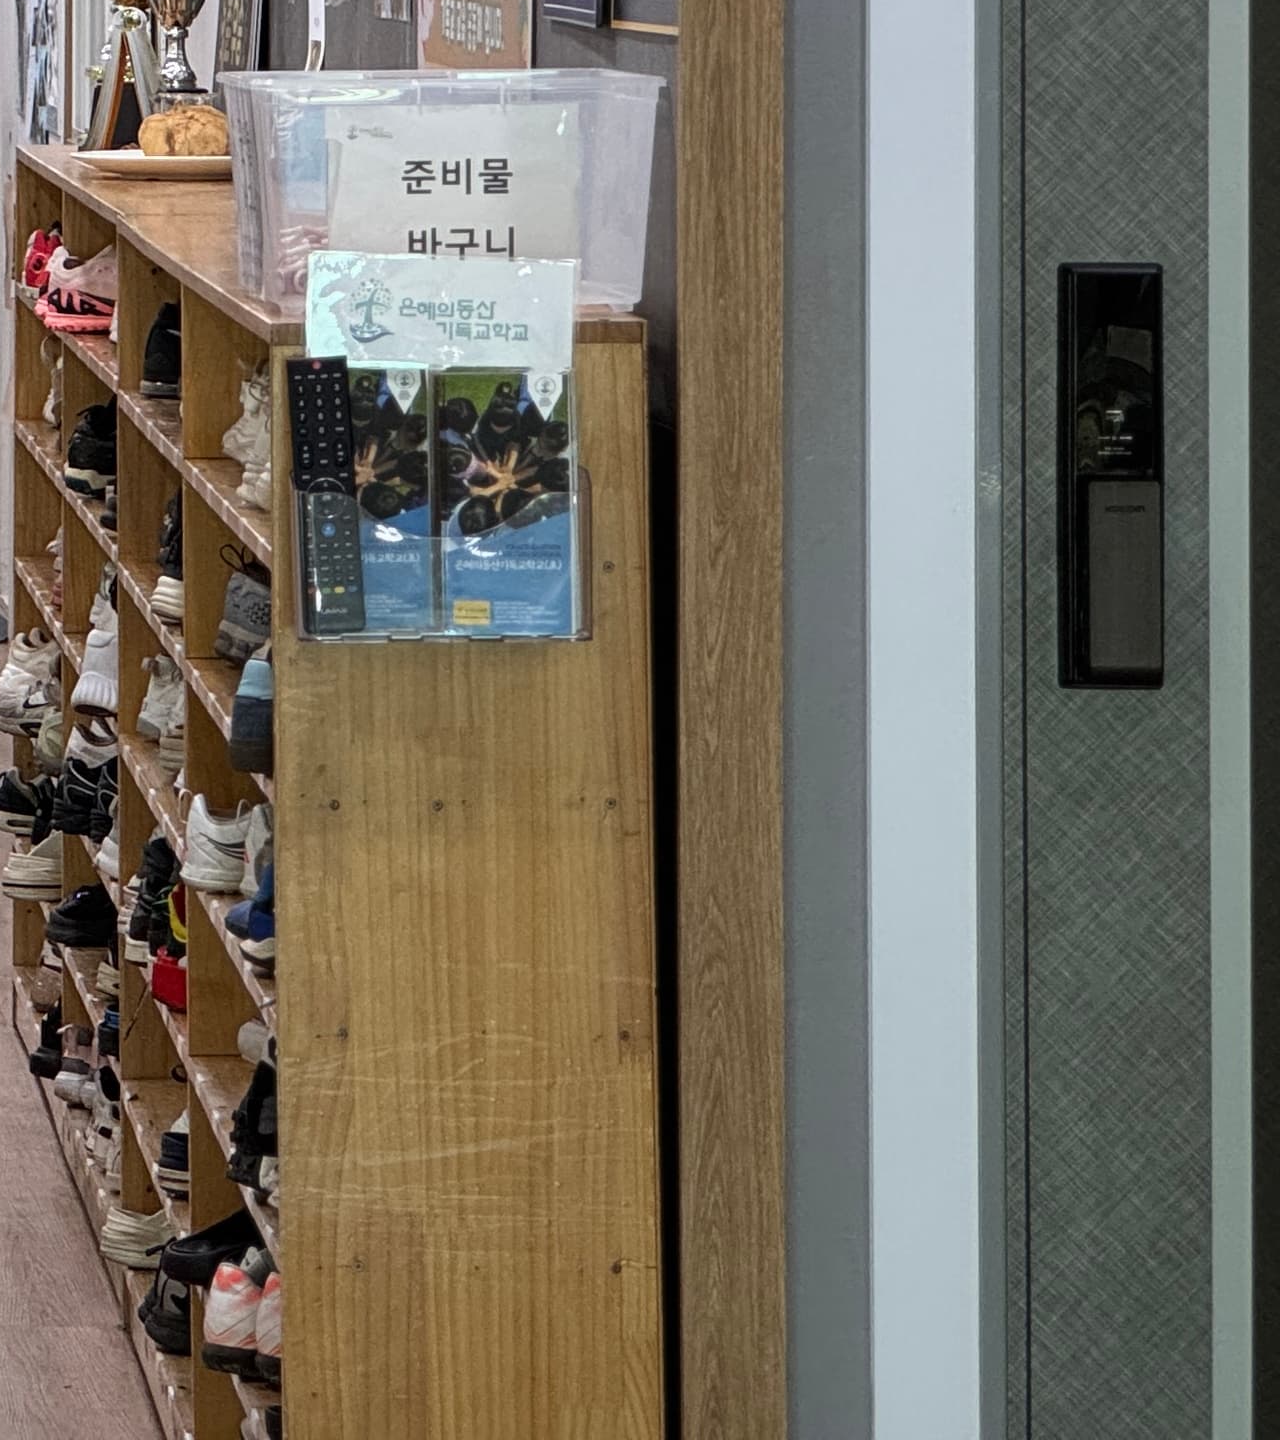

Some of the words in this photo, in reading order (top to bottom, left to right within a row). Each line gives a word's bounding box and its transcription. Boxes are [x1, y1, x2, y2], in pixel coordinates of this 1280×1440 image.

[401, 158, 513, 195] 준비물
[407, 226, 515, 261] 바구니
[399, 297, 496, 321] 은혜의동산
[436, 321, 529, 342] 기독교학교
